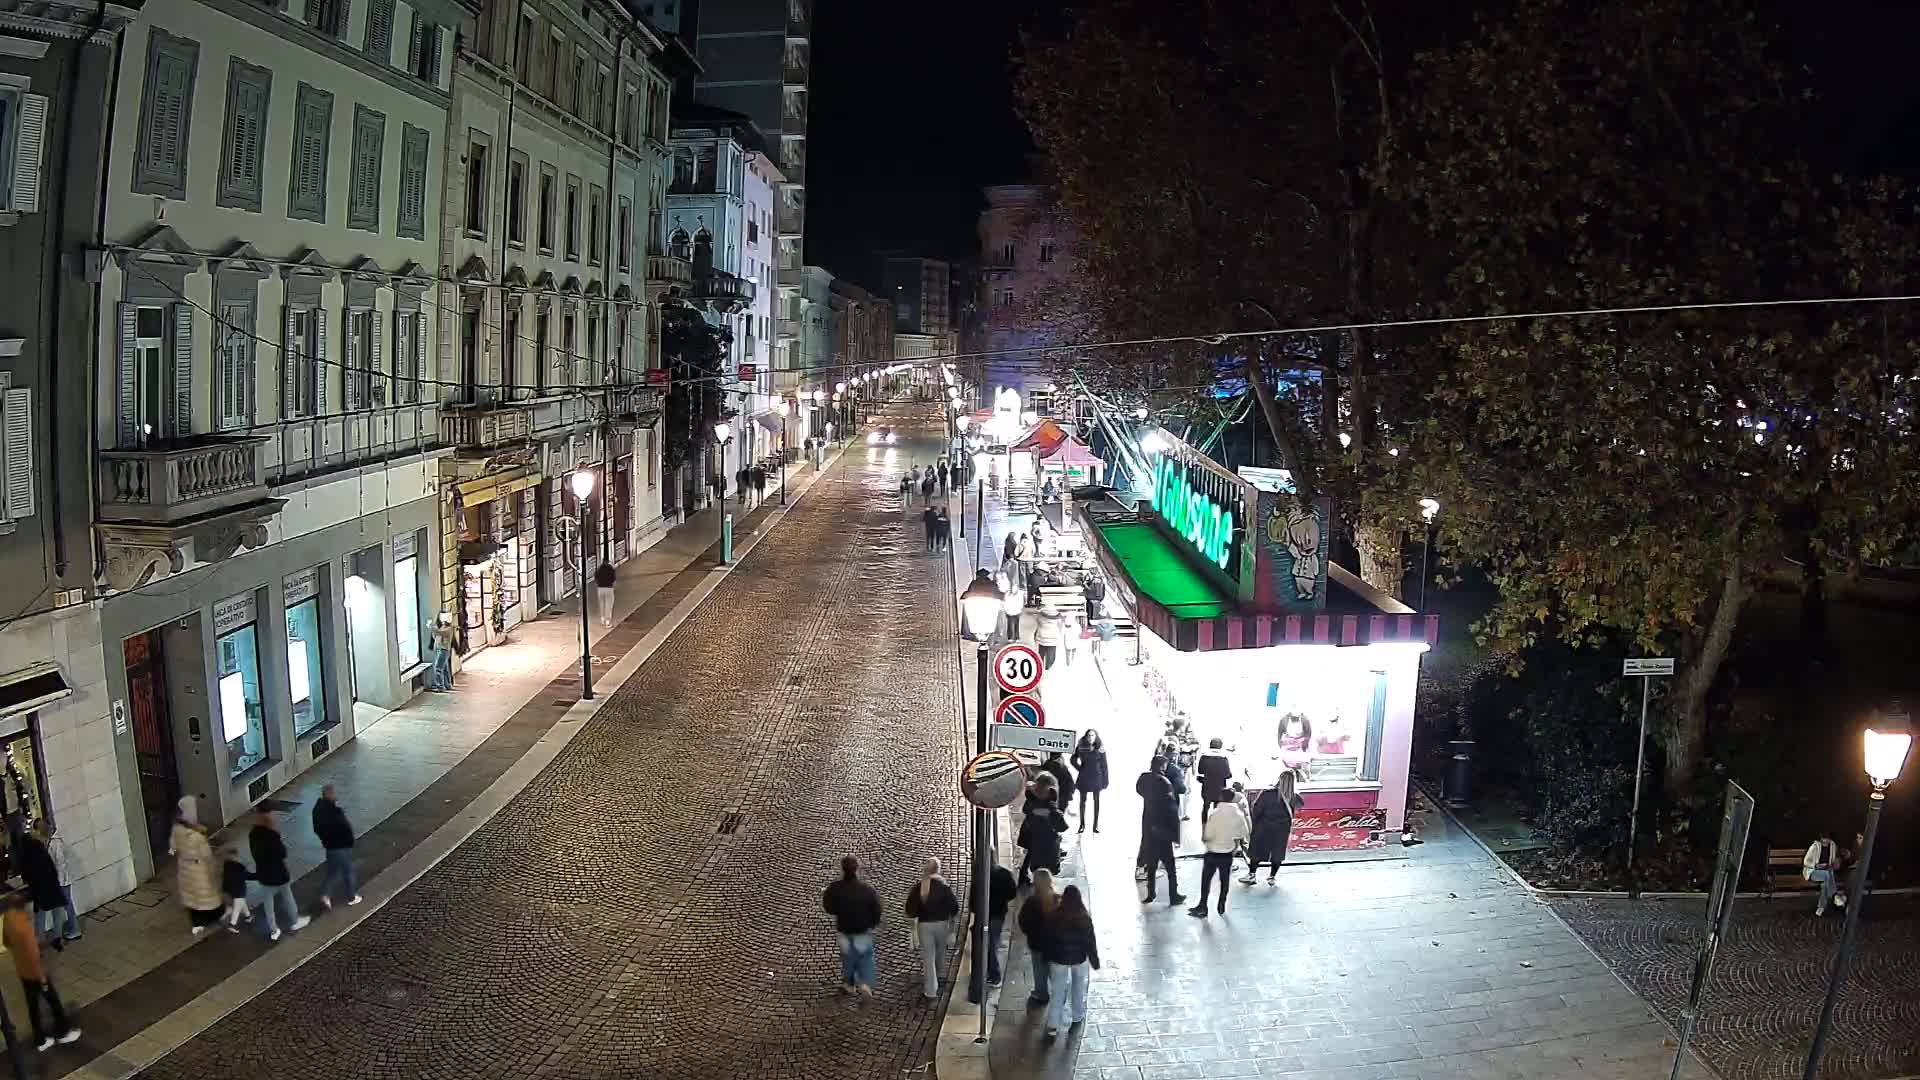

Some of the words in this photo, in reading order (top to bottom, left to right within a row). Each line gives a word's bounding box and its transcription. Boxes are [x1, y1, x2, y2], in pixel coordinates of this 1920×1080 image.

[233, 598, 254, 611] CREDITO
[1005, 657, 1033, 680] 30
[1038, 737, 1070, 749] Dante
